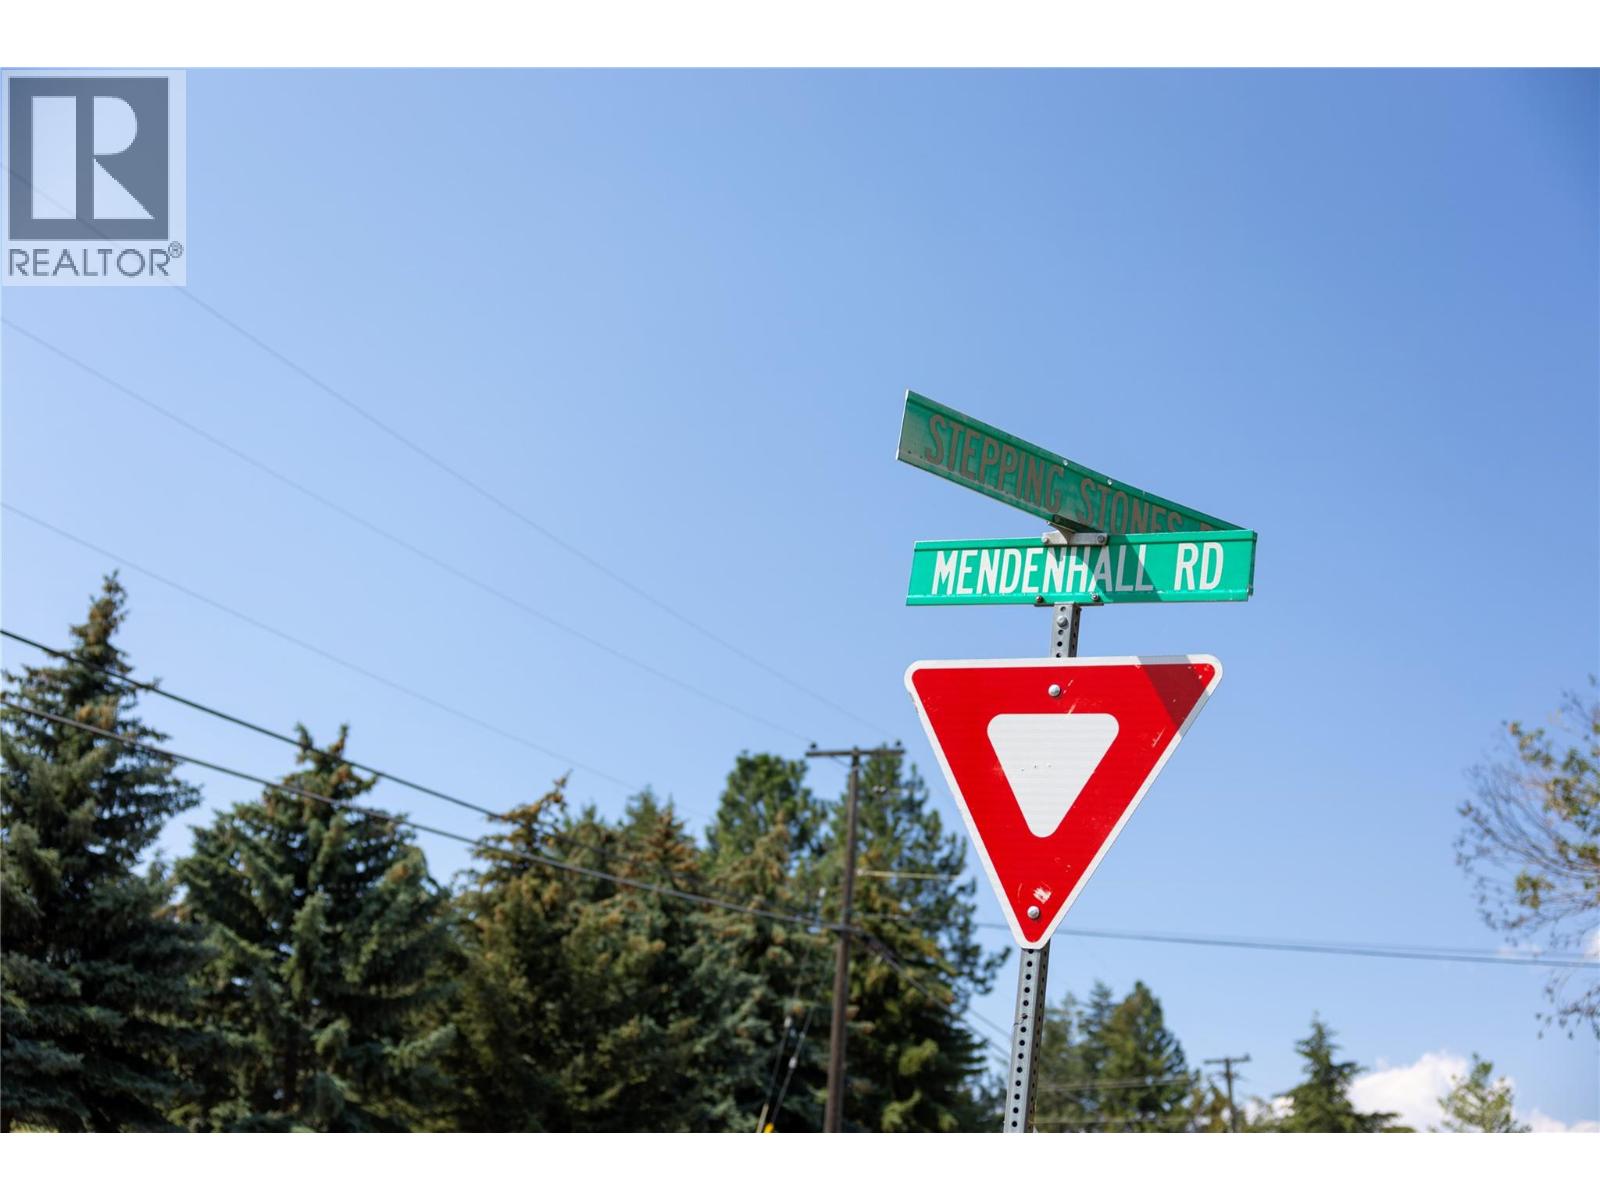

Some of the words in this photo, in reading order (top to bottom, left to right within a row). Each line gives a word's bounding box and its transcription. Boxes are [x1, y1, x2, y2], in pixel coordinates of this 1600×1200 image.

[924, 414, 1065, 514] STEPPING
[931, 544, 1154, 595] MENDENHALL
[1173, 542, 1225, 591] RD
